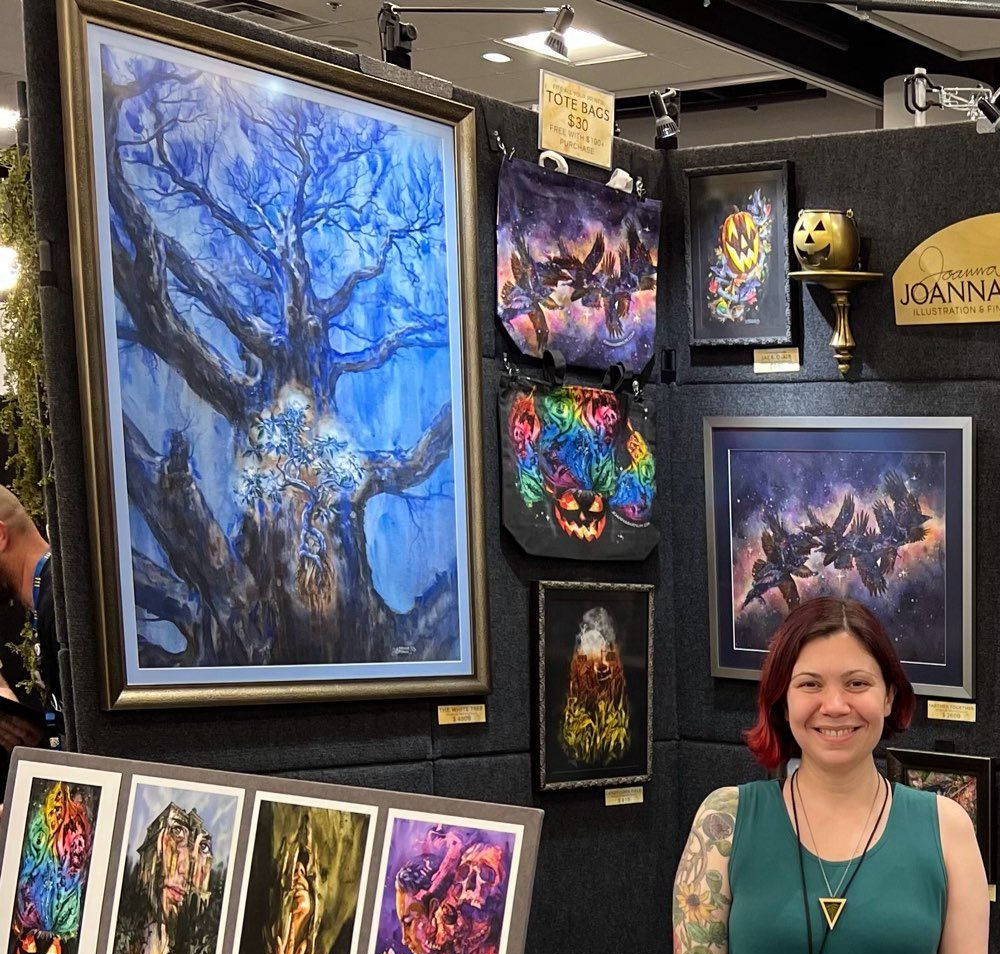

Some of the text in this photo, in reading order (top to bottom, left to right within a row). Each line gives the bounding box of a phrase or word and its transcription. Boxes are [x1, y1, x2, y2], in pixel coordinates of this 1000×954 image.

[546, 90, 578, 111] TOTE
[581, 101, 610, 122] BAGS
[567, 113, 589, 132] $30
[549, 124, 567, 137] FREE
[568, 129, 585, 141] WITH
[559, 138, 595, 155] PURCHASE
[913, 305, 977, 317] ILLUSTRATION
[978, 305, 985, 314] &
